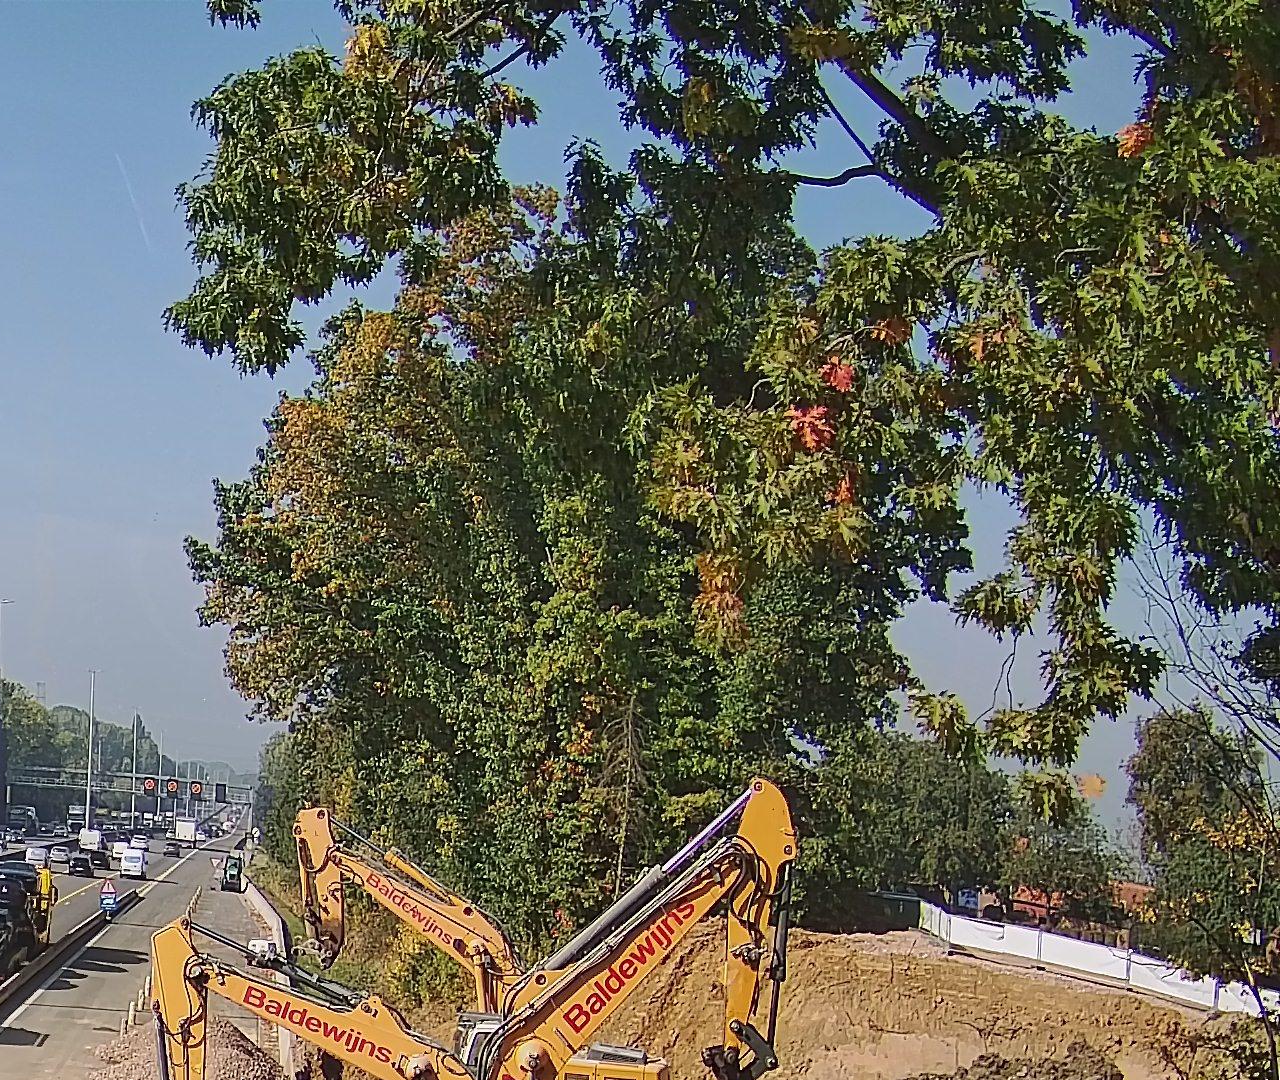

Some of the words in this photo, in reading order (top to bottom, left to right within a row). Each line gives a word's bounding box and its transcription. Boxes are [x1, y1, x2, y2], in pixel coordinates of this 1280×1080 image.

[366, 873, 453, 945] Baldewijns
[562, 902, 695, 1034] Baldewijns
[242, 985, 393, 1064] Baldewijns
